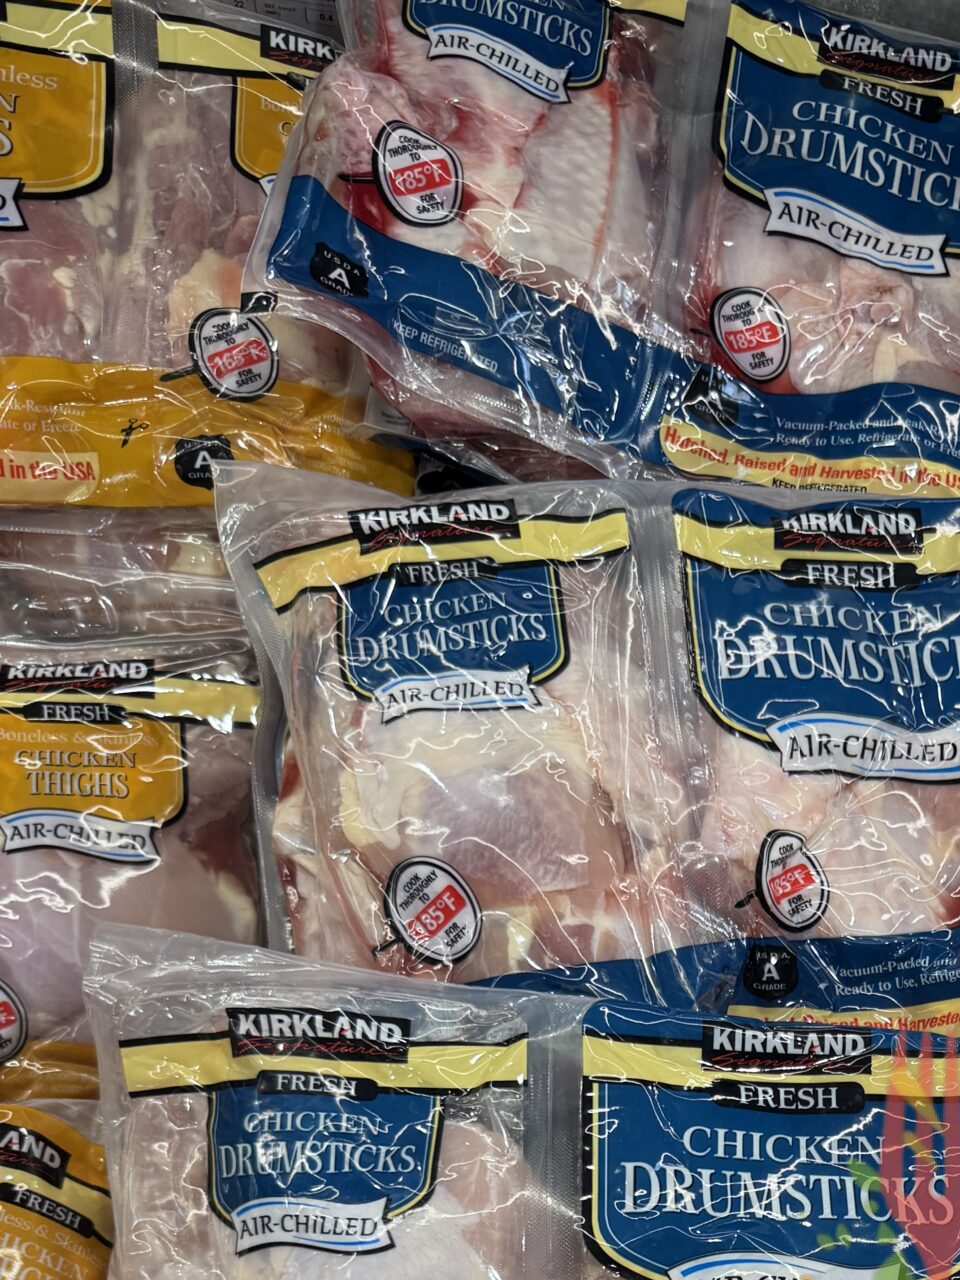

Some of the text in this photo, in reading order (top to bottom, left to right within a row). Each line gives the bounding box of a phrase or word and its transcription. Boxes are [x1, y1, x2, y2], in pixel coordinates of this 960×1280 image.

[829, 26, 952, 72] KIRKLAND
[434, 34, 560, 94] AIR-CHILLED
[843, 76, 923, 116] FRESH
[792, 100, 954, 165] CHICKEN
[778, 201, 934, 262] AIR-CHILLED
[360, 503, 510, 532] KIRKLAND
[783, 511, 916, 536] KIRKLAND
[407, 562, 480, 583] FRESH
[806, 563, 896, 589] FRESH
[383, 592, 507, 626] CHICKEN
[763, 602, 942, 636] CHICKEN
[357, 613, 549, 663] DRUMSTICKS
[7, 661, 149, 680] KIRKLAND
[387, 681, 524, 709] AIR-CHILLED
[42, 704, 110, 722] FRESH
[15, 750, 137, 769] CHICKEN
[788, 733, 958, 763] AIR-CHILLED
[27, 772, 130, 800] THIGHS
[831, 956, 930, 978] Vacuum-Packed
[238, 1012, 404, 1044] KIRKLAND
[712, 1027, 865, 1056] KIRKLAND
[276, 1074, 358, 1096] FRESH
[738, 1084, 839, 1110] FRESH
[243, 1111, 384, 1136] CHICKEN
[683, 1125, 886, 1166] CHICKEN
[218, 1143, 417, 1180] DRUMSTICKS
[620, 1161, 955, 1226] DRUMSTICKS
[15, 1190, 82, 1229] FRESH
[239, 1214, 379, 1240] AIR-CHILLED
